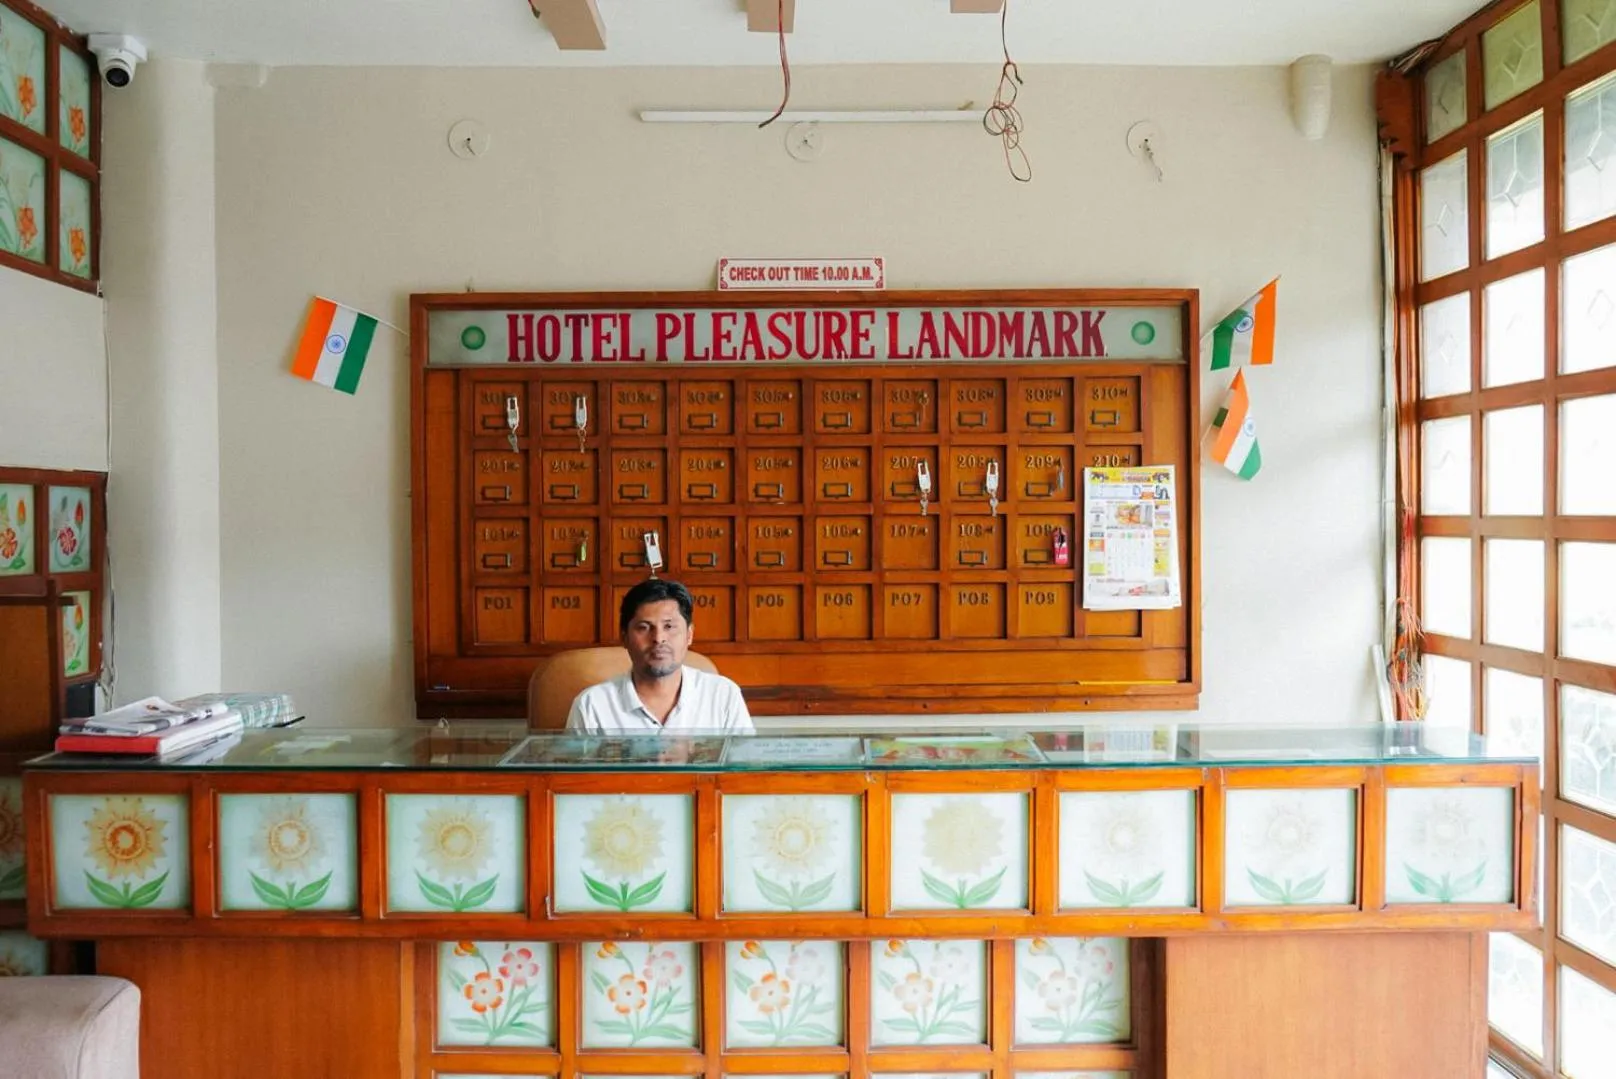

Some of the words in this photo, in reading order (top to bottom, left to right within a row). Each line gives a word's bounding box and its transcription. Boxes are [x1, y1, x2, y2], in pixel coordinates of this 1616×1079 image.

[729, 266, 765, 281] CHECK
[768, 266, 791, 281] OUT
[793, 266, 819, 281] TIME
[822, 266, 849, 281] 10.00
[851, 266, 874, 281] A.M.
[507, 313, 646, 362] HOTEL
[656, 311, 875, 361] PLEASURE
[886, 311, 1107, 358] LANDMARK
[891, 456, 918, 470] 207
[1025, 455, 1054, 469] 209
[1093, 454, 1120, 468] 210
